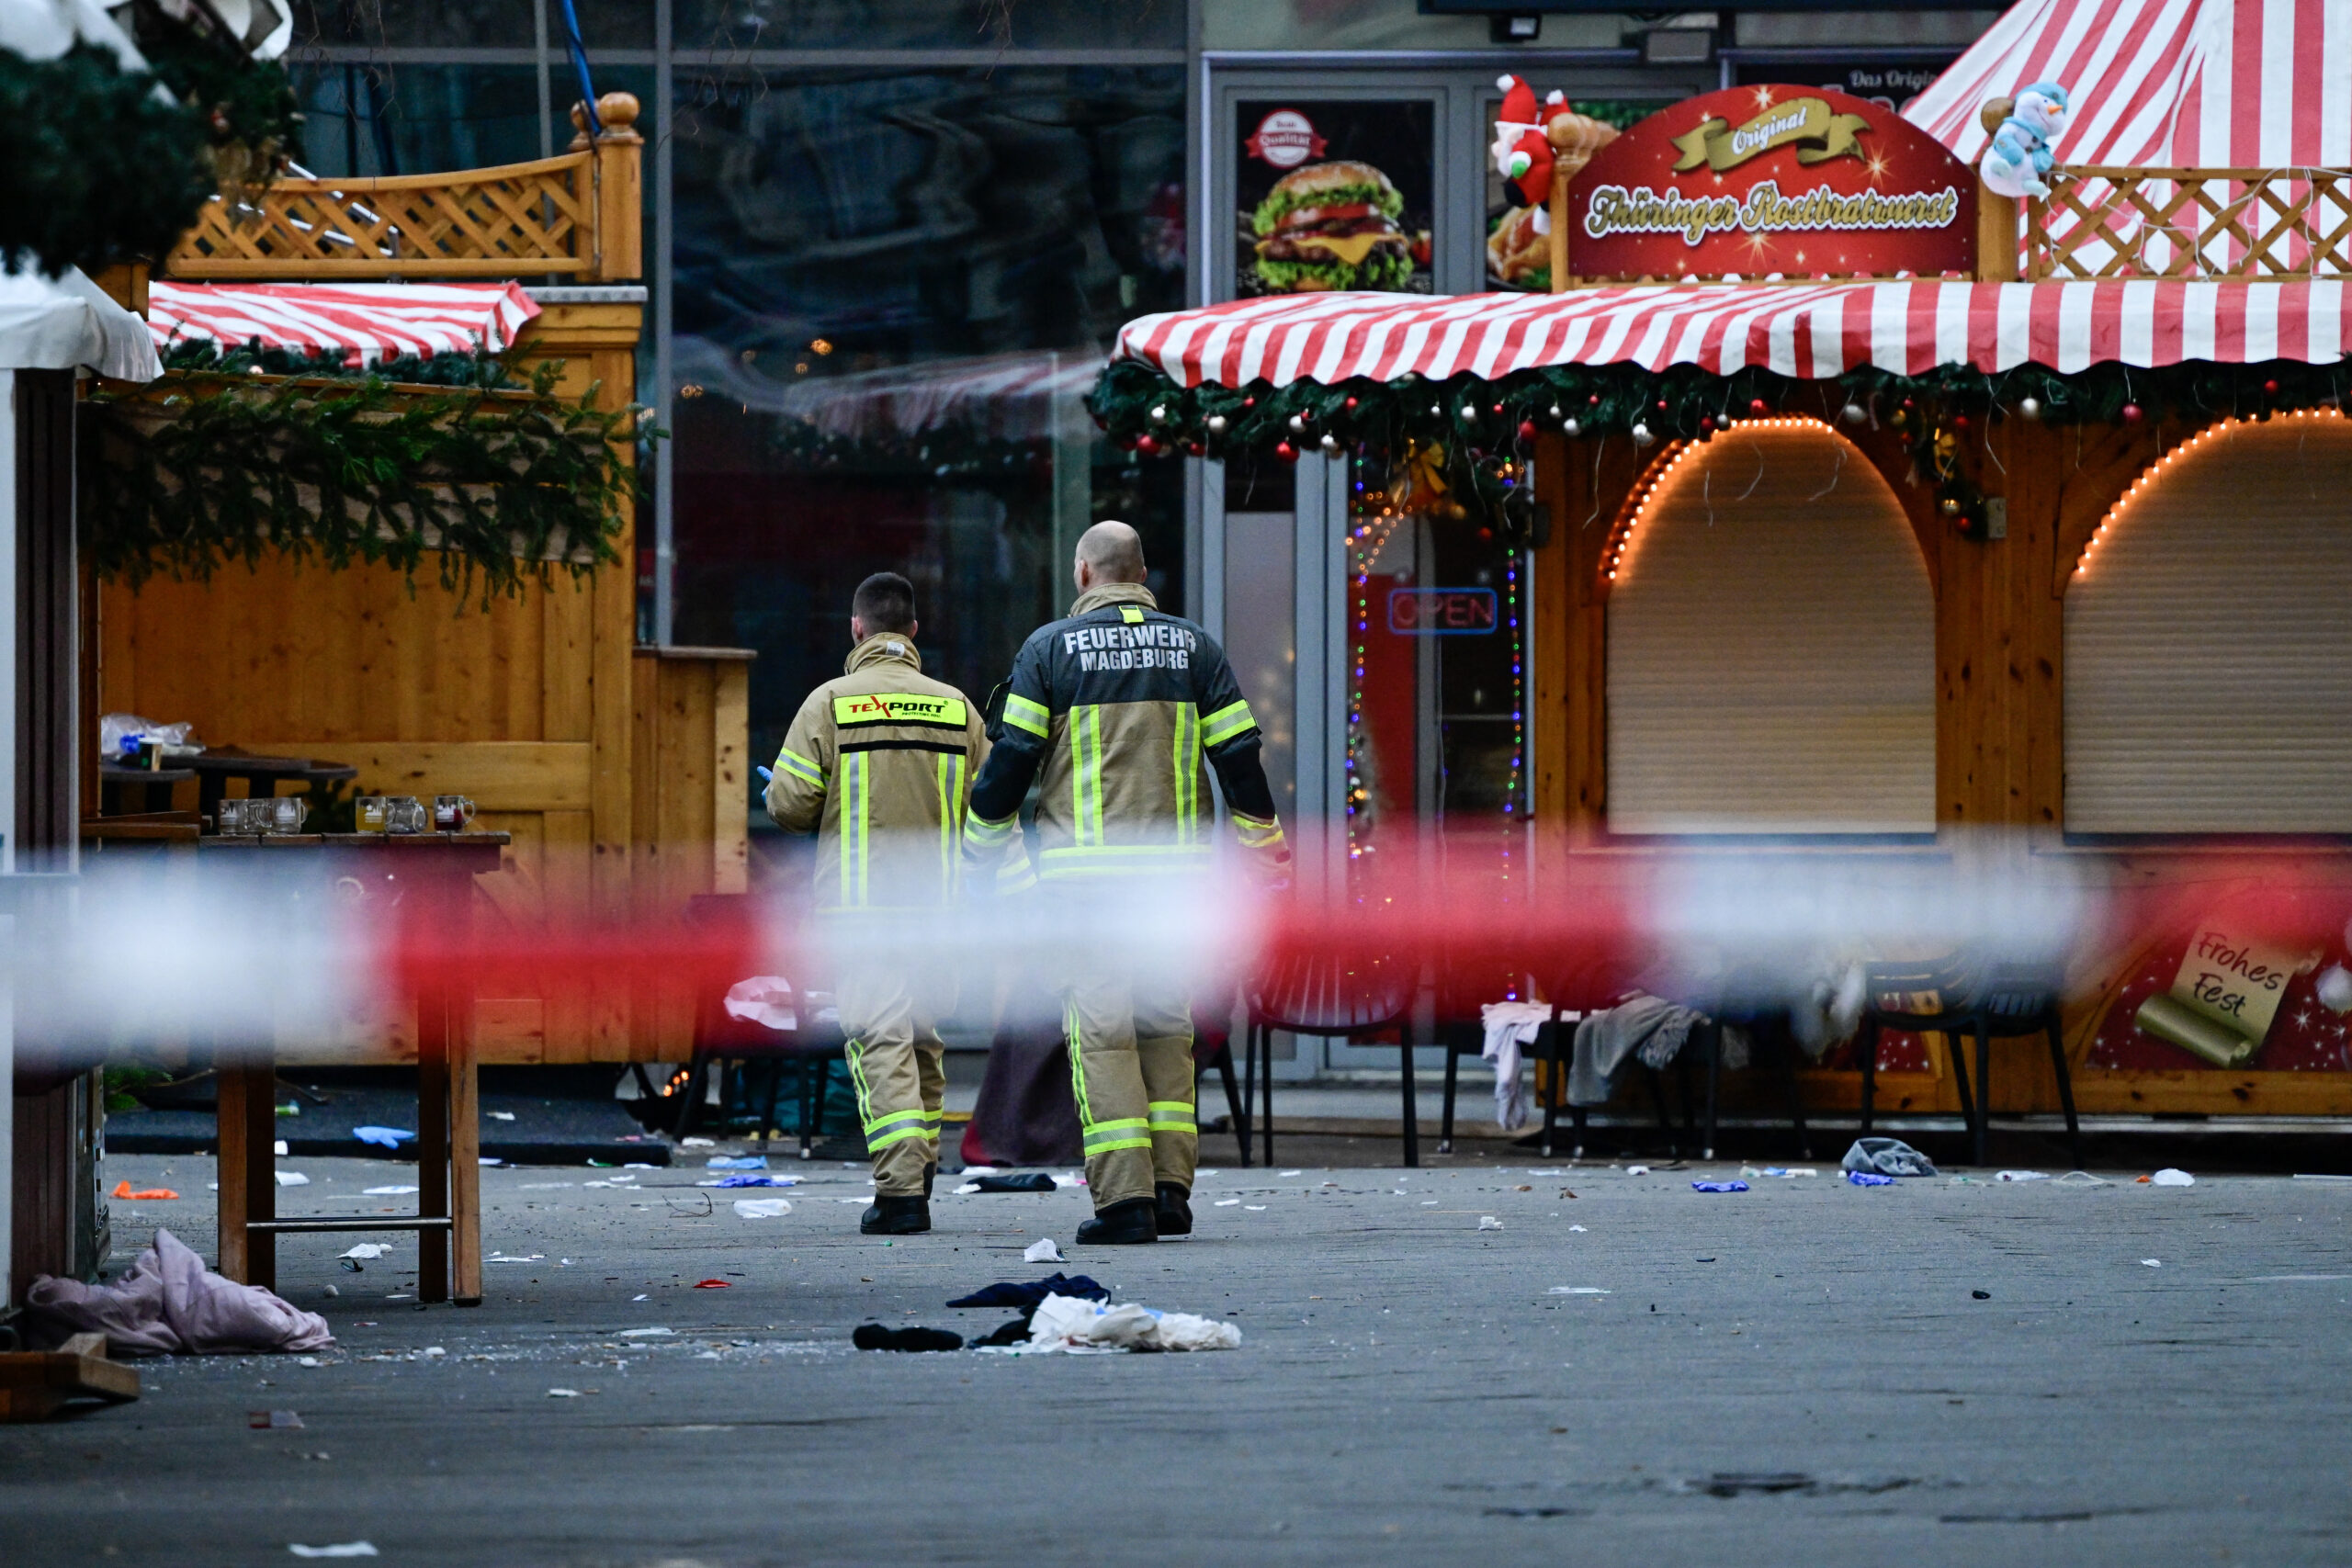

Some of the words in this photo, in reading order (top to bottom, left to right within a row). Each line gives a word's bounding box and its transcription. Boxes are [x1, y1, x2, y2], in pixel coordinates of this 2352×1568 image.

[1850, 70, 1882, 87] Das
[1731, 106, 1807, 156] Original
[1587, 185, 1740, 245] Thüringer
[1739, 180, 1958, 233] Rostbratwurst
[1394, 594, 1494, 626] OPEN
[1064, 626, 1196, 654] FEUERWEHR
[1080, 649, 1189, 671] MAGDEBURG
[2198, 931, 2283, 990] Frohes
[2194, 973, 2246, 1017] Fest
